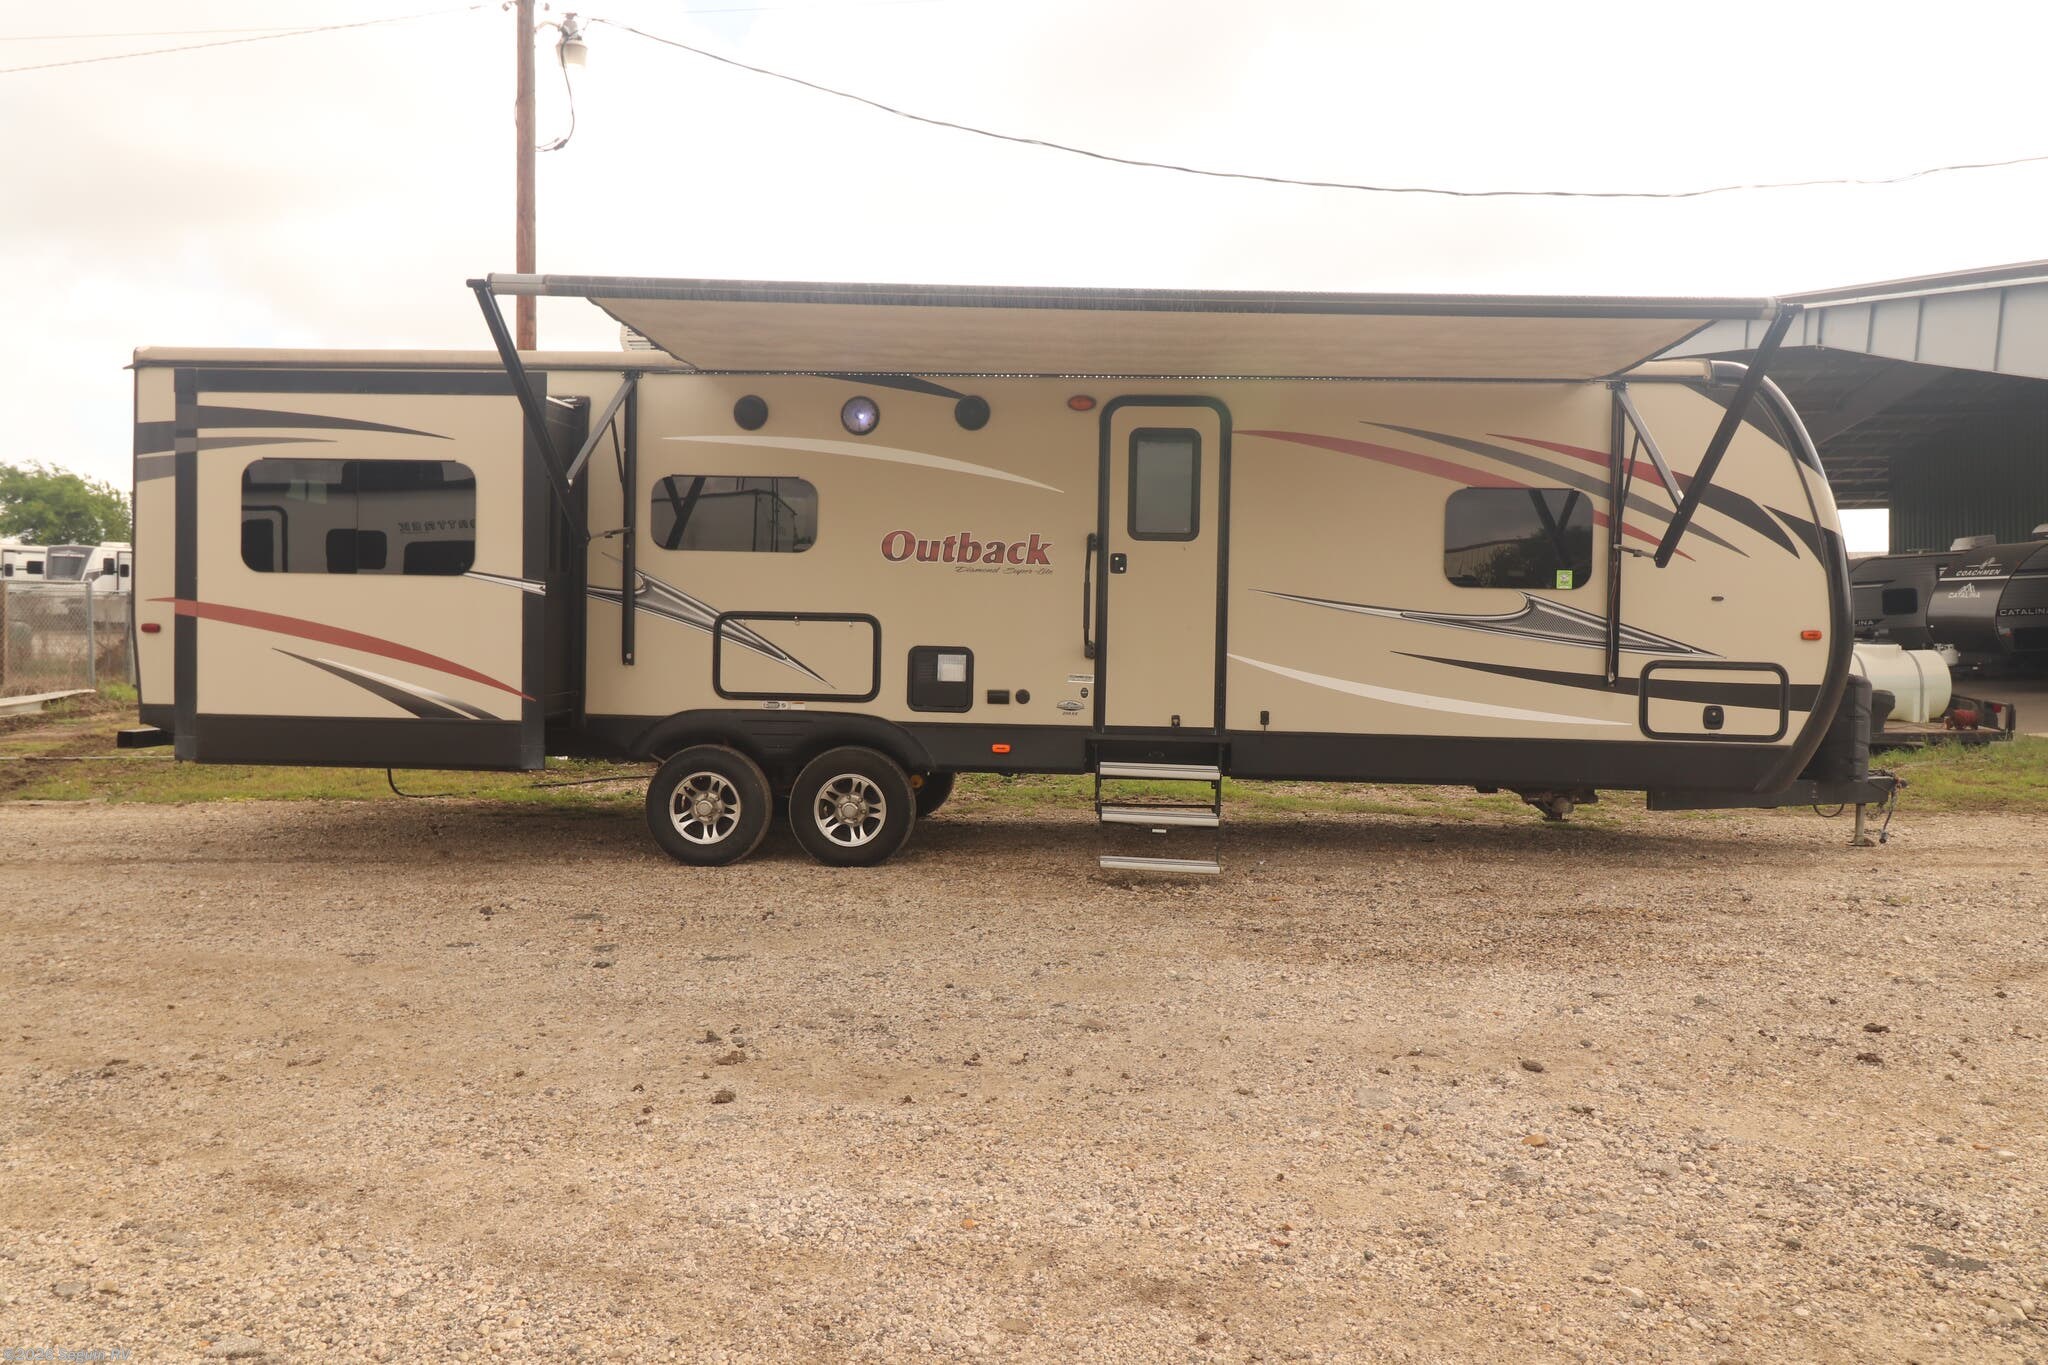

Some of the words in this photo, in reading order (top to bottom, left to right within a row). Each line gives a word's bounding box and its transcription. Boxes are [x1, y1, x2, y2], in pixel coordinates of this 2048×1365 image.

[881, 530, 1053, 566] Outback
[1955, 569, 2001, 577] COACHMEN
[1948, 591, 1981, 599] CATALINA
